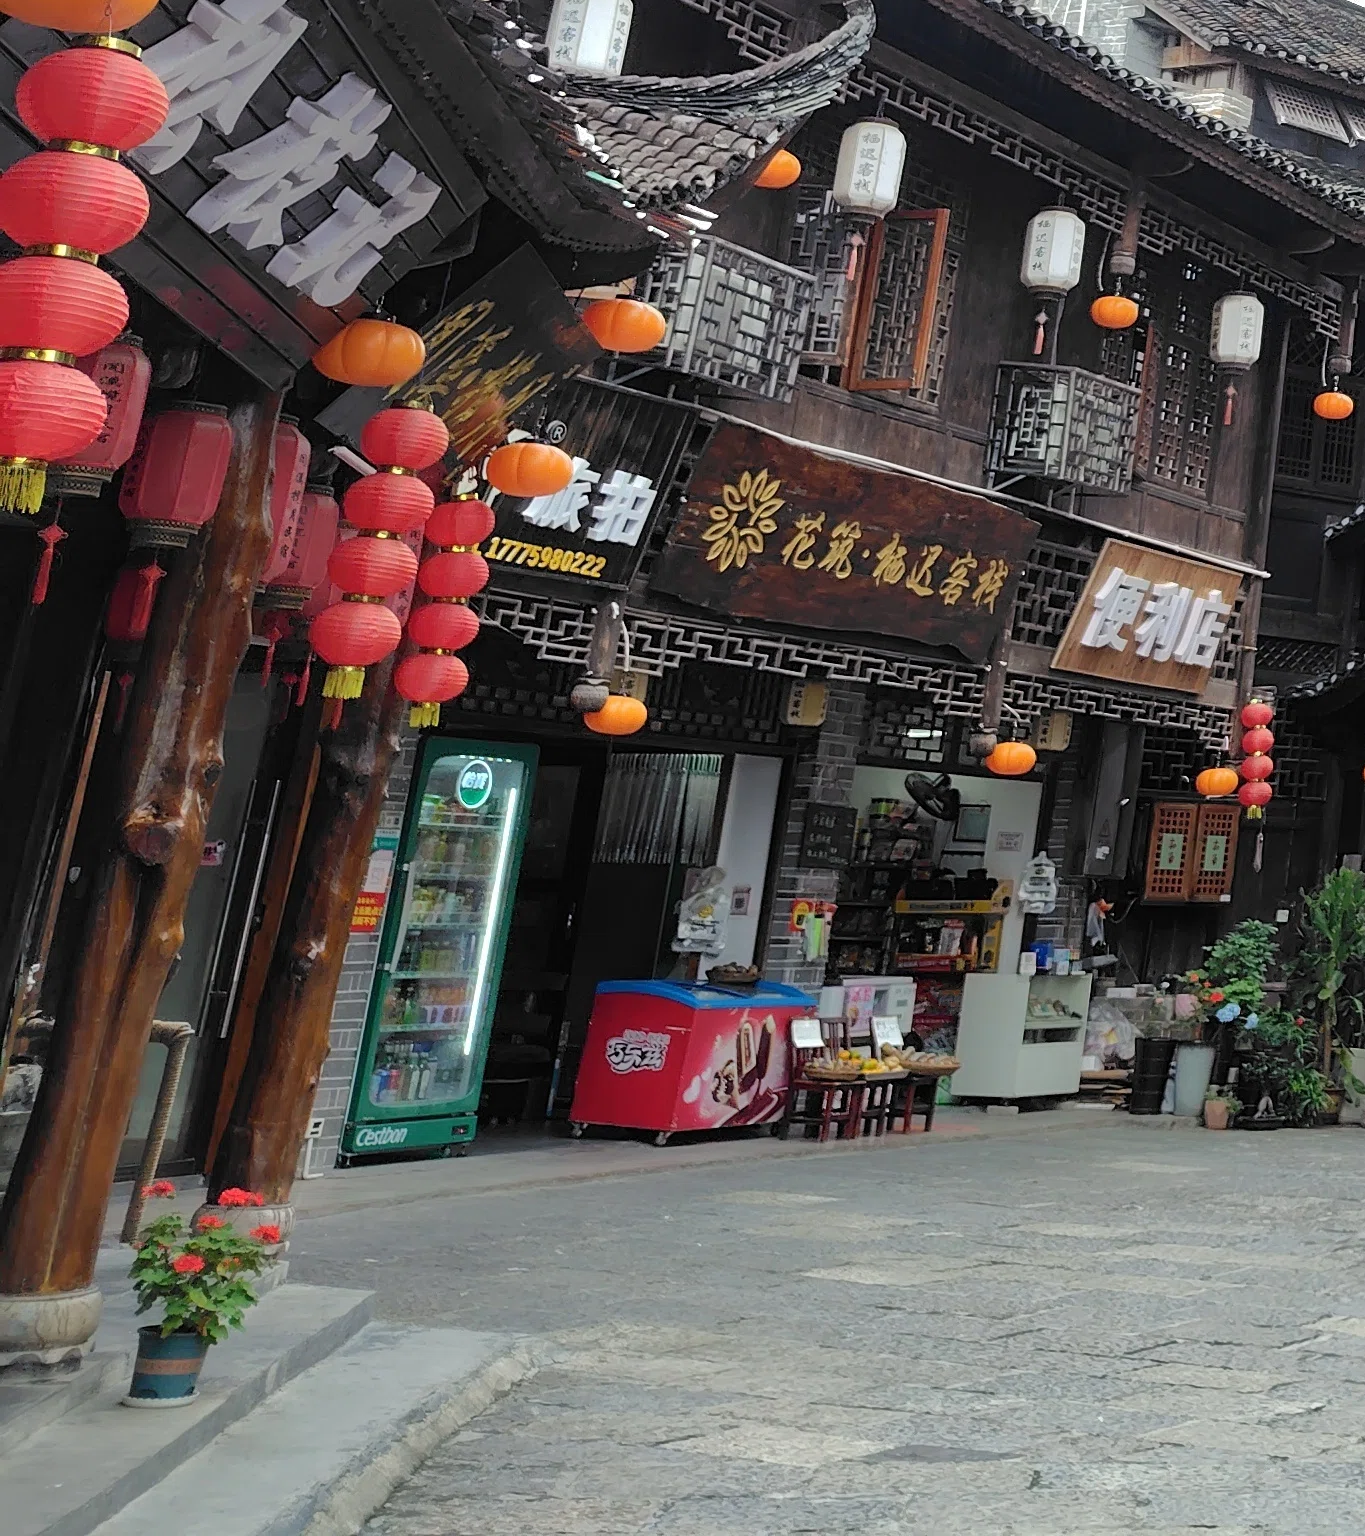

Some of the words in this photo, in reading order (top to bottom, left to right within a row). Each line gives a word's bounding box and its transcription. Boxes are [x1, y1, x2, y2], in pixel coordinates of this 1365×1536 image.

[488, 537, 607, 578] 17775980222
[1080, 566, 1232, 668] 便利店
